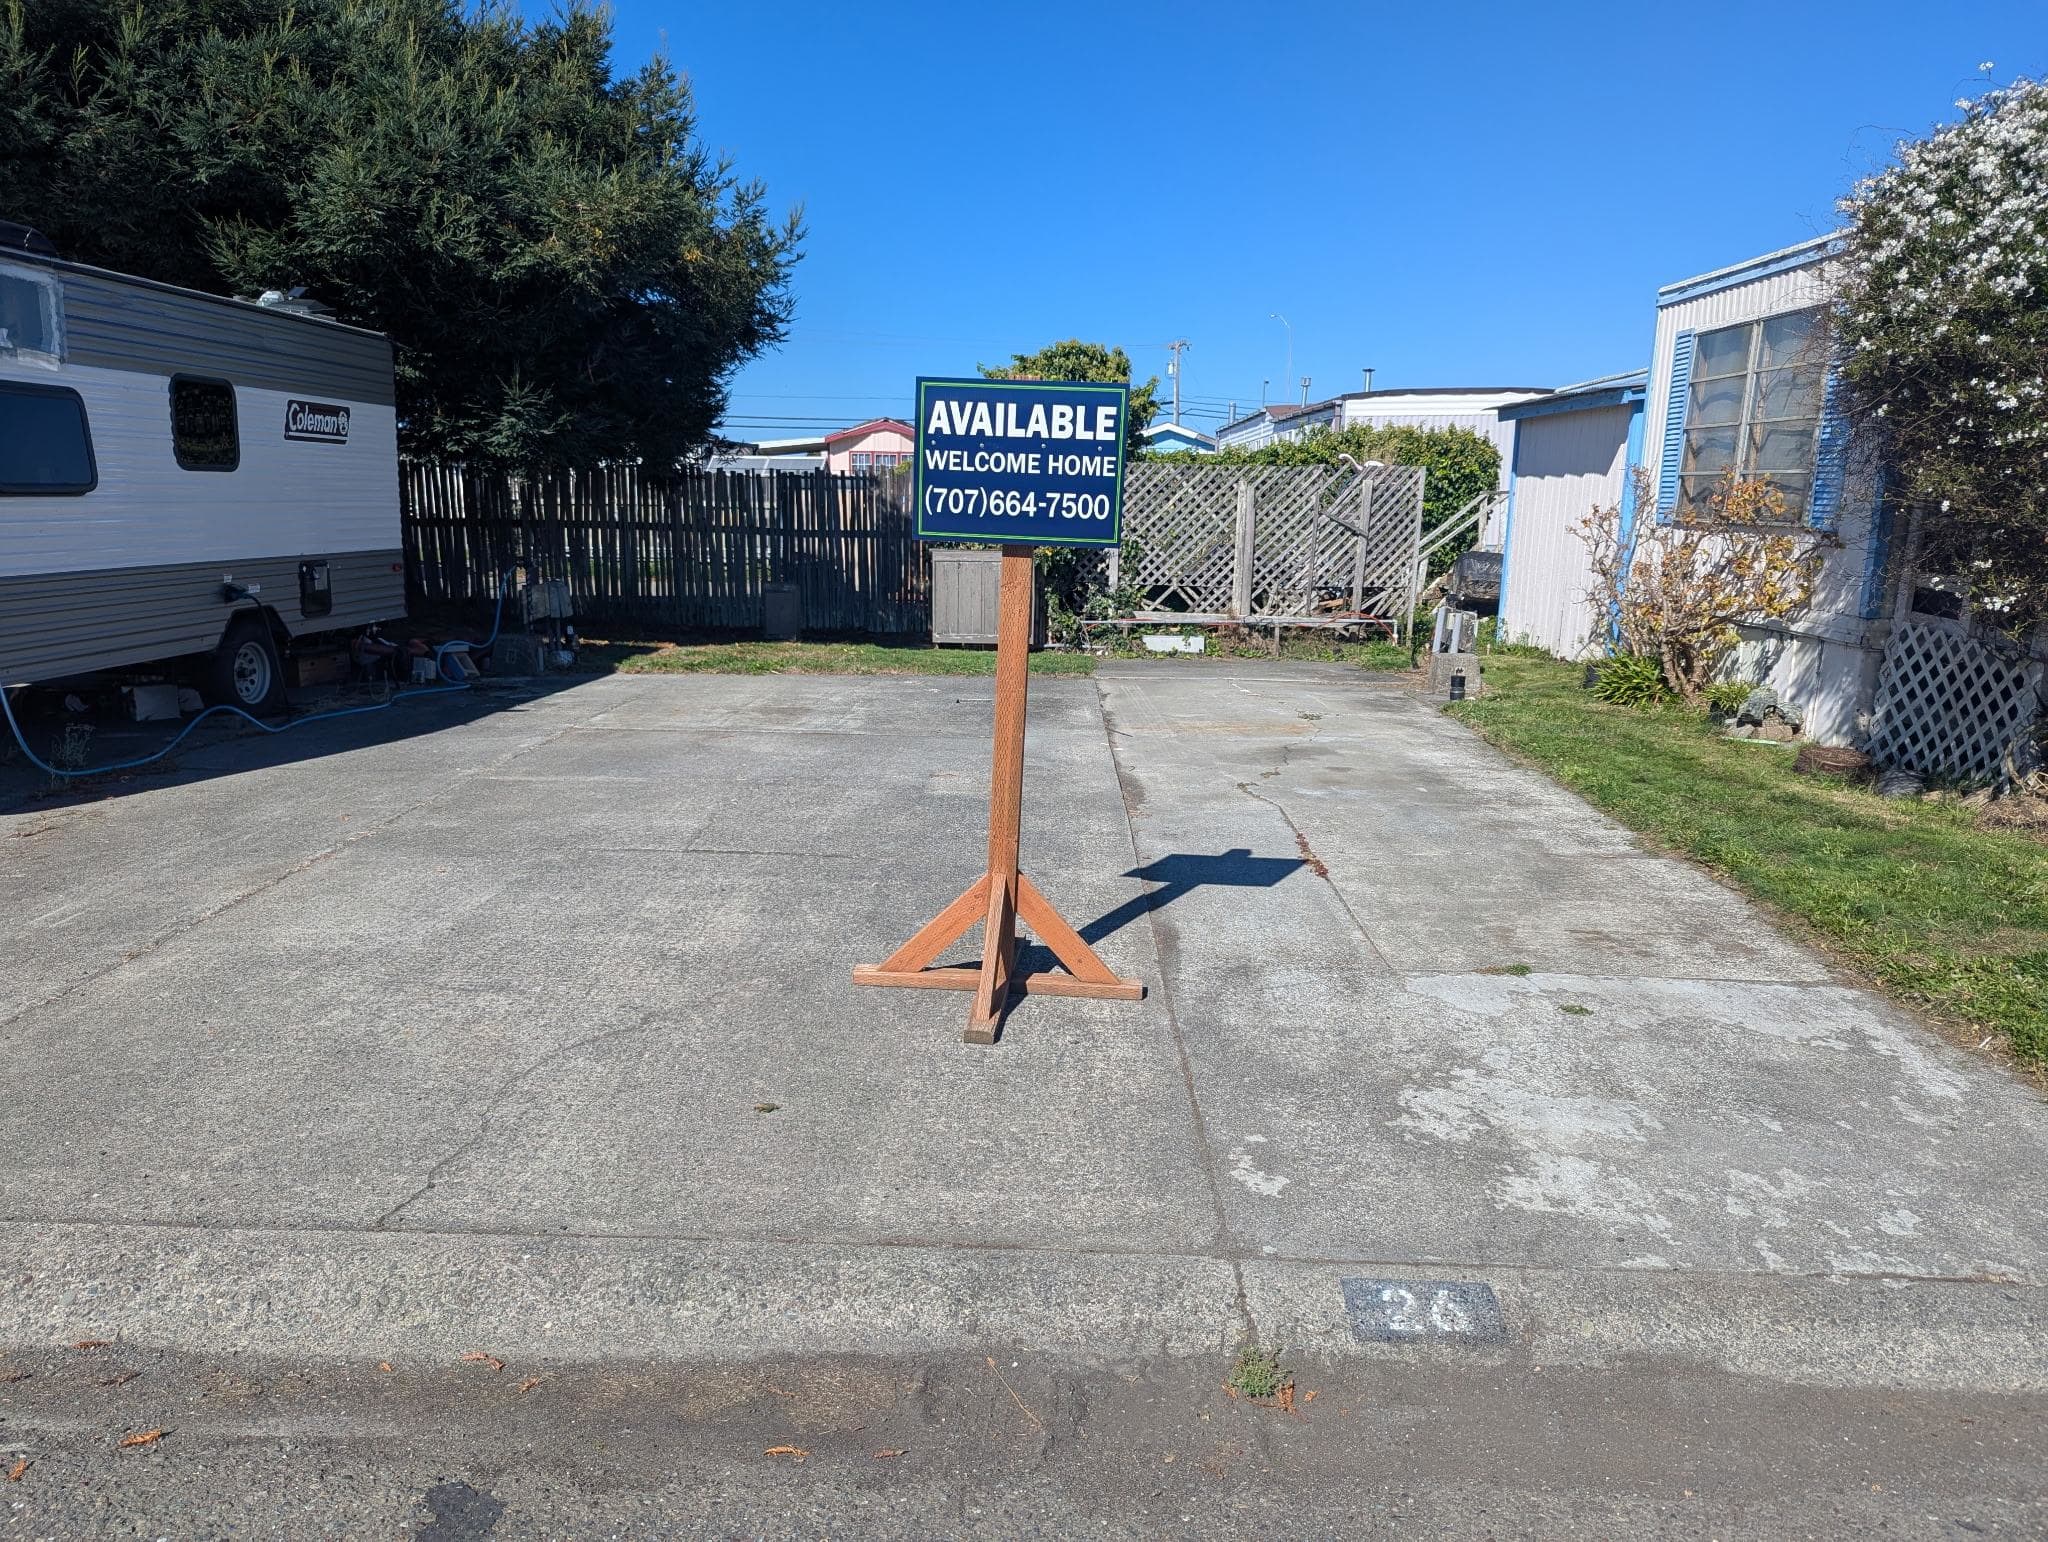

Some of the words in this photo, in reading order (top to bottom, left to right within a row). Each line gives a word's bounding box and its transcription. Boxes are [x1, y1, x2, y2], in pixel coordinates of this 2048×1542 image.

[289, 403, 338, 433] Coleman
[927, 400, 1118, 441] AVAILABLE
[925, 449, 1041, 474] WELCOME
[1048, 454, 1116, 477] HOME
[925, 484, 1110, 520] (707)664-7500
